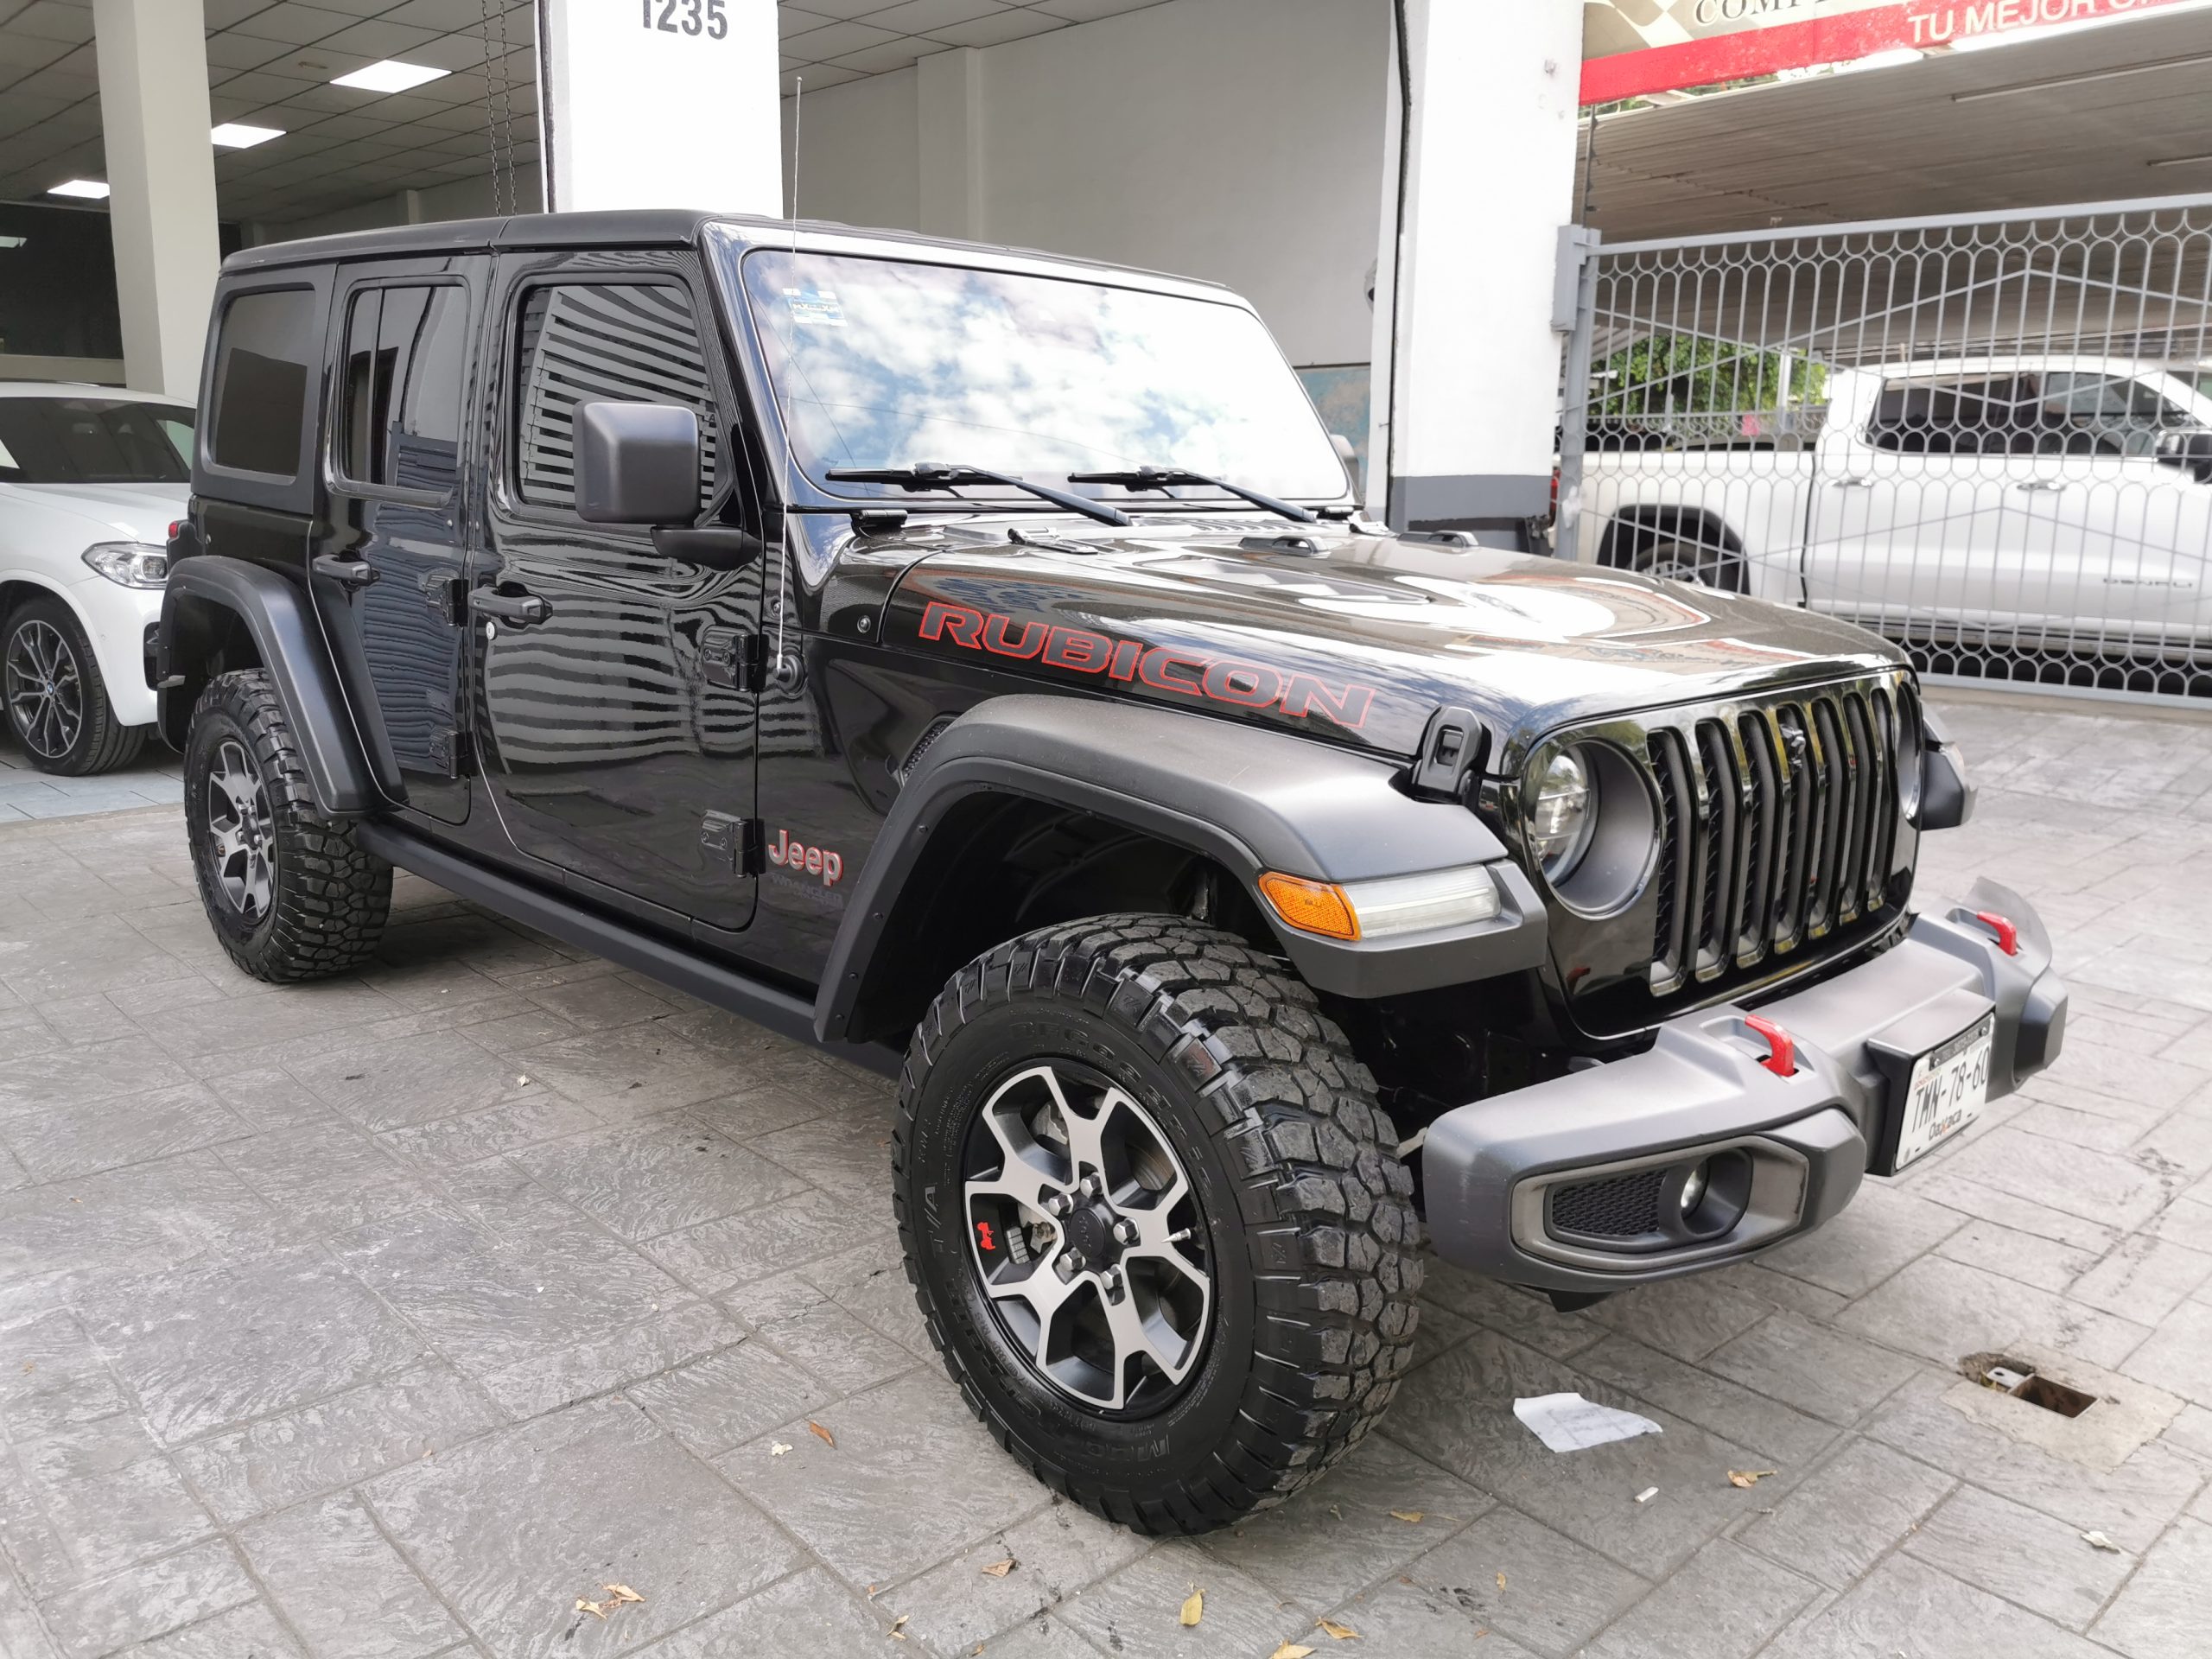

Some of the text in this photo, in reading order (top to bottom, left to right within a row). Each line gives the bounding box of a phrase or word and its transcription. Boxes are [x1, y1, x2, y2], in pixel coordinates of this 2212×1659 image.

[643, 0, 728, 40] 1235
[1908, 10, 1954, 42] TU
[918, 601, 1377, 728] RUBICON
[768, 830, 844, 887] Jeep
